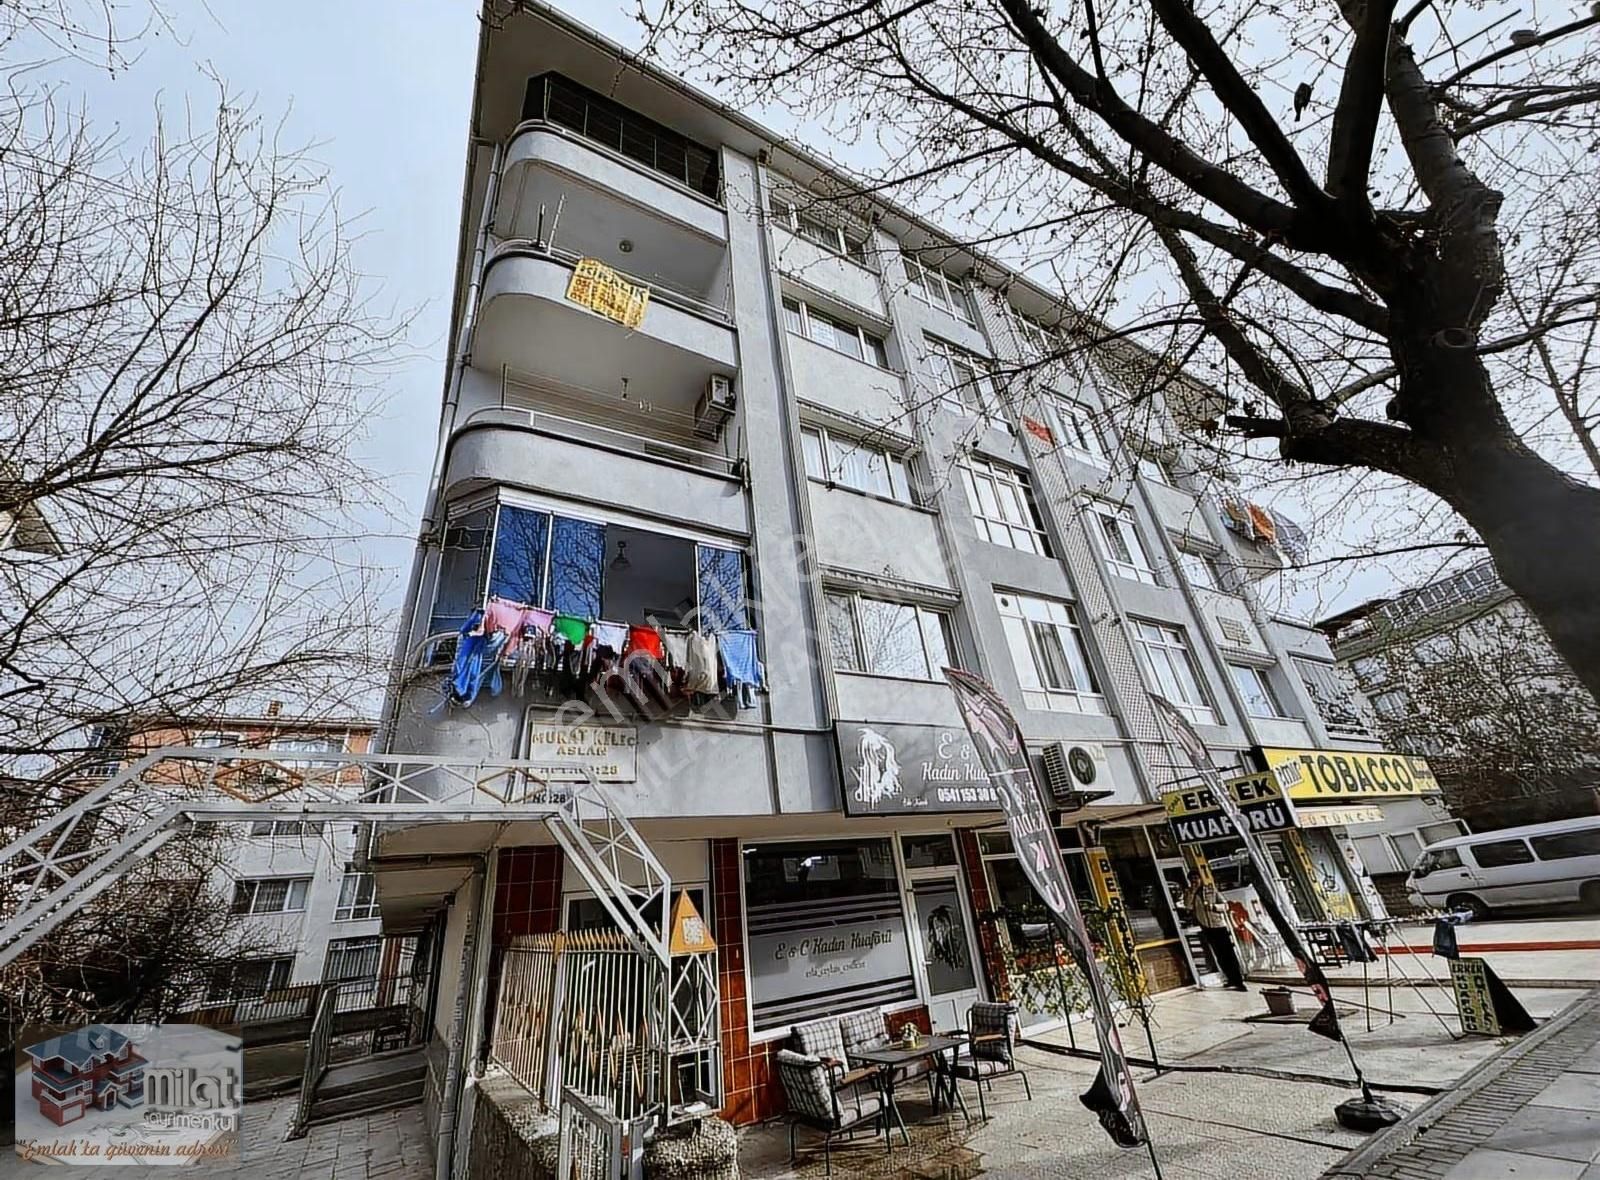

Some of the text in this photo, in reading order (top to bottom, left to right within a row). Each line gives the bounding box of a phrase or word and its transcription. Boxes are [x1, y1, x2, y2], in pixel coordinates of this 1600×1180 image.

[938, 732, 970, 760] E &
[921, 762, 961, 781] Kadın
[1300, 754, 1414, 794] TOBACCO
[1181, 777, 1276, 811] EREK
[775, 942, 786, 960] E
[800, 939, 809, 956] C
[812, 936, 845, 954] Kadın
